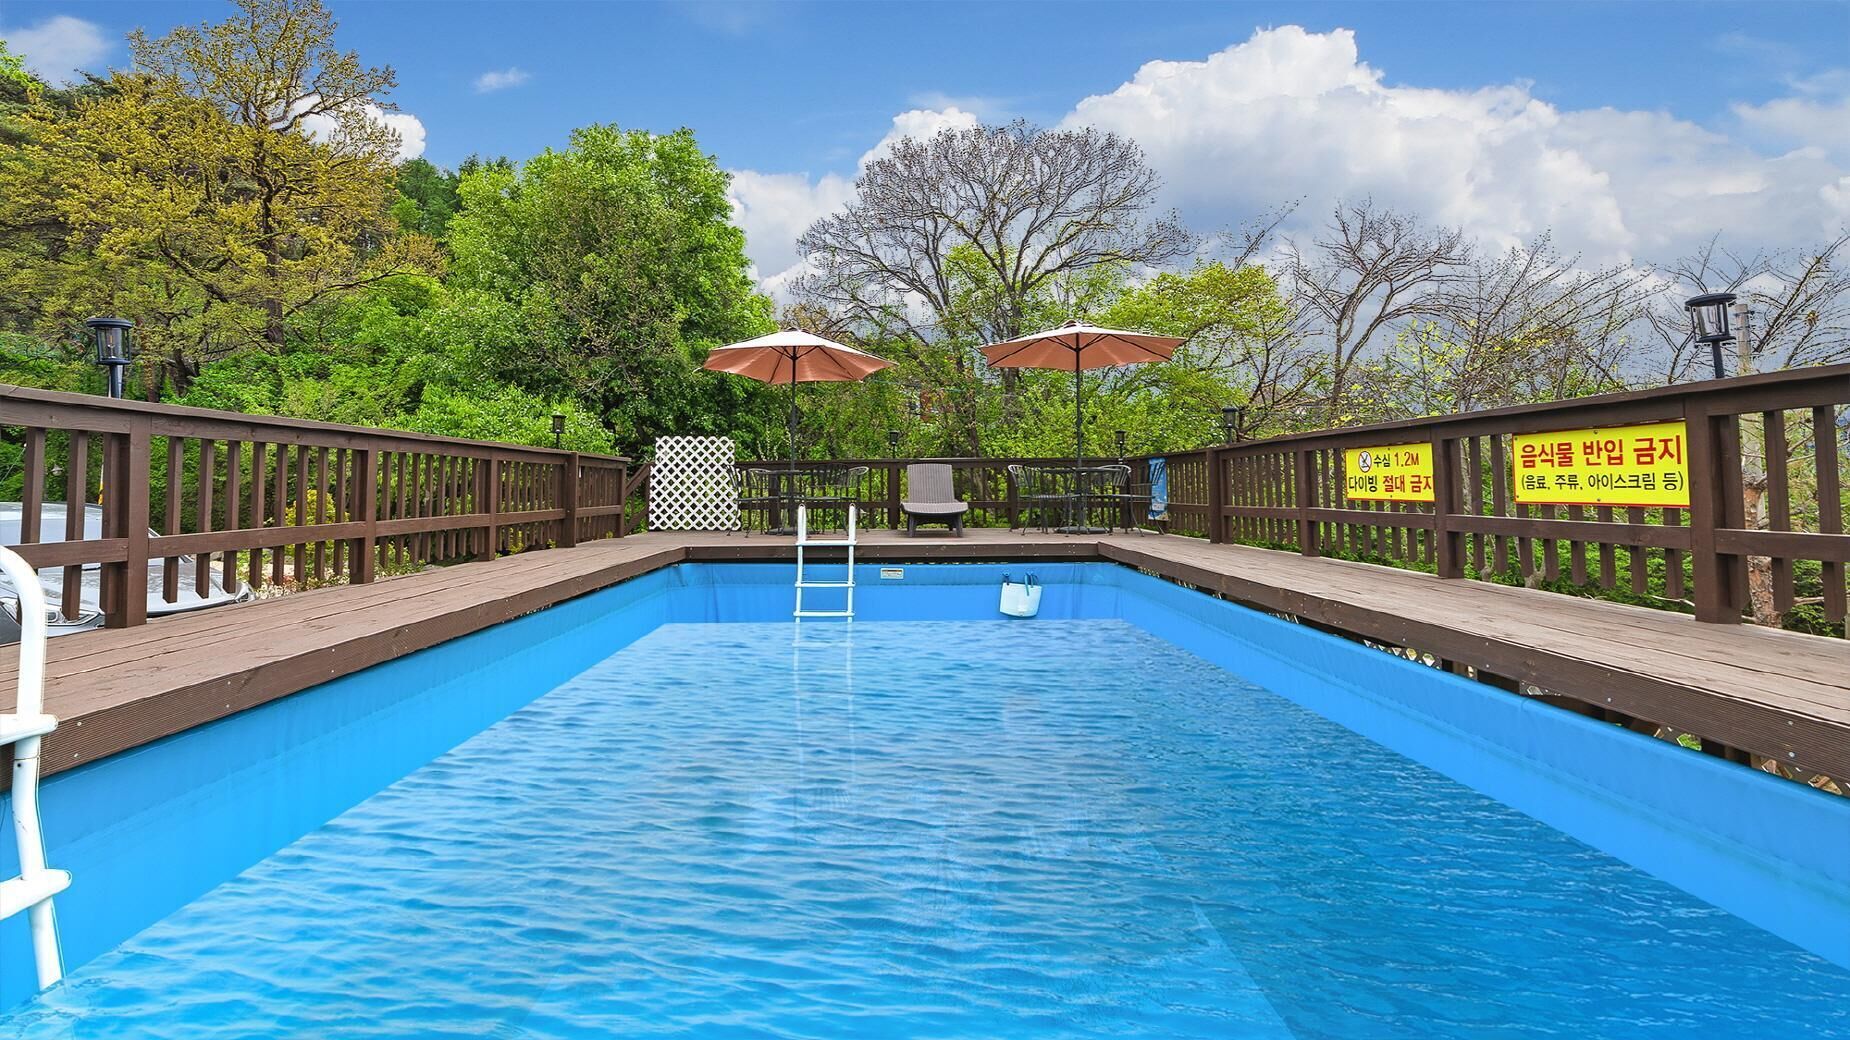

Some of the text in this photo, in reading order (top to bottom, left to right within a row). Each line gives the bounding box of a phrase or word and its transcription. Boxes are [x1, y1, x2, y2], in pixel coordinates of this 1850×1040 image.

[1373, 451, 1420, 468] 수심 1.2M
[1520, 434, 1682, 469] 음식물 반입 금지
[1348, 475, 1378, 493] 다이빙
[1382, 475, 1406, 493] 절대
[1588, 472, 1656, 490] 아이스크림
[1662, 471, 1684, 491] 등)
